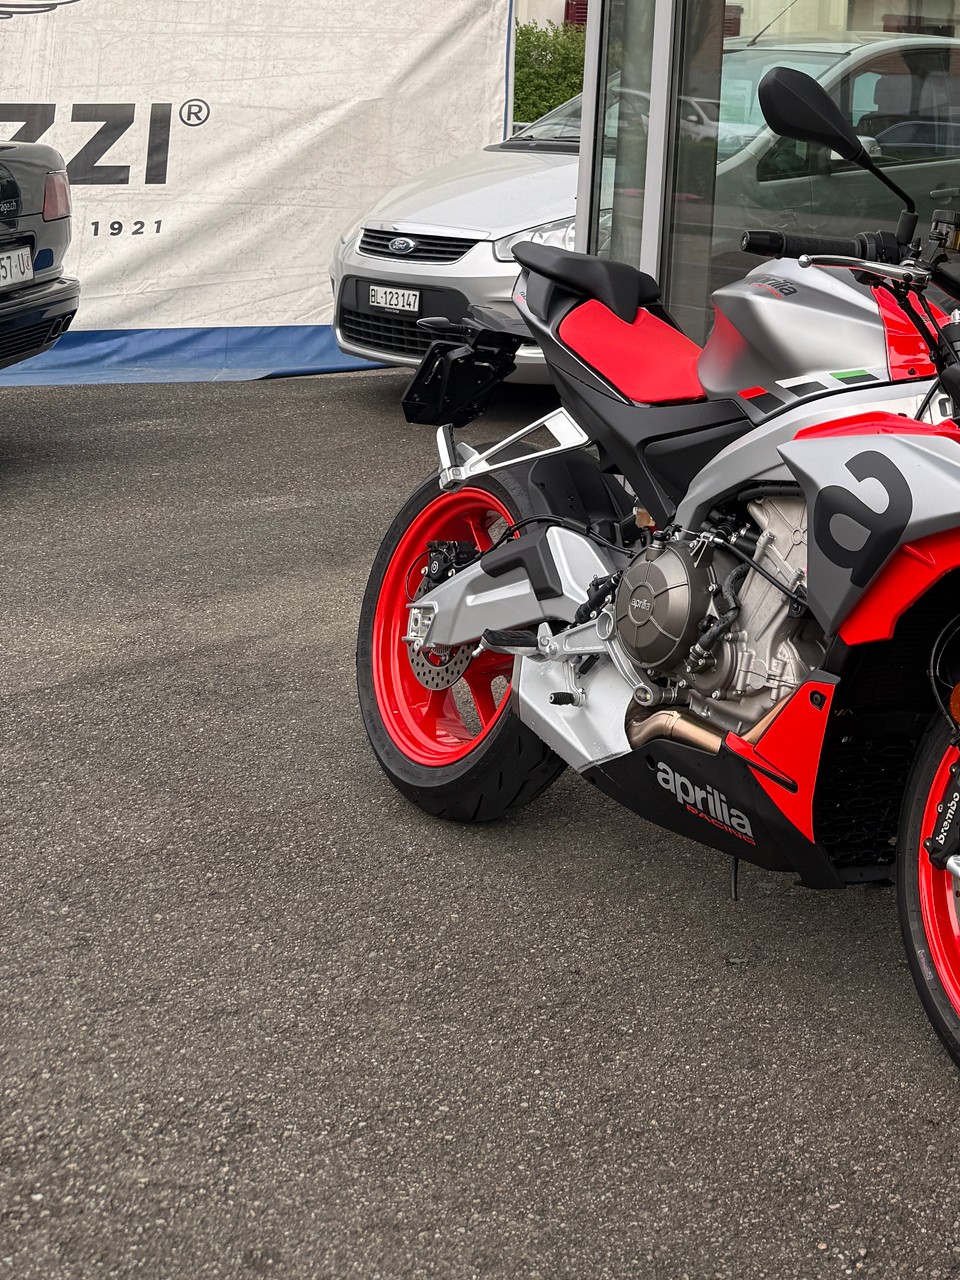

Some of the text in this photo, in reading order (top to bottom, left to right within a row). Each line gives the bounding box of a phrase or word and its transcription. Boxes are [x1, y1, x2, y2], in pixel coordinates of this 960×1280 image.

[91, 220, 162, 237] 1921
[631, 597, 651, 611] aprilia
[656, 761, 754, 838] aprilia
[935, 792, 960, 846] brembo
